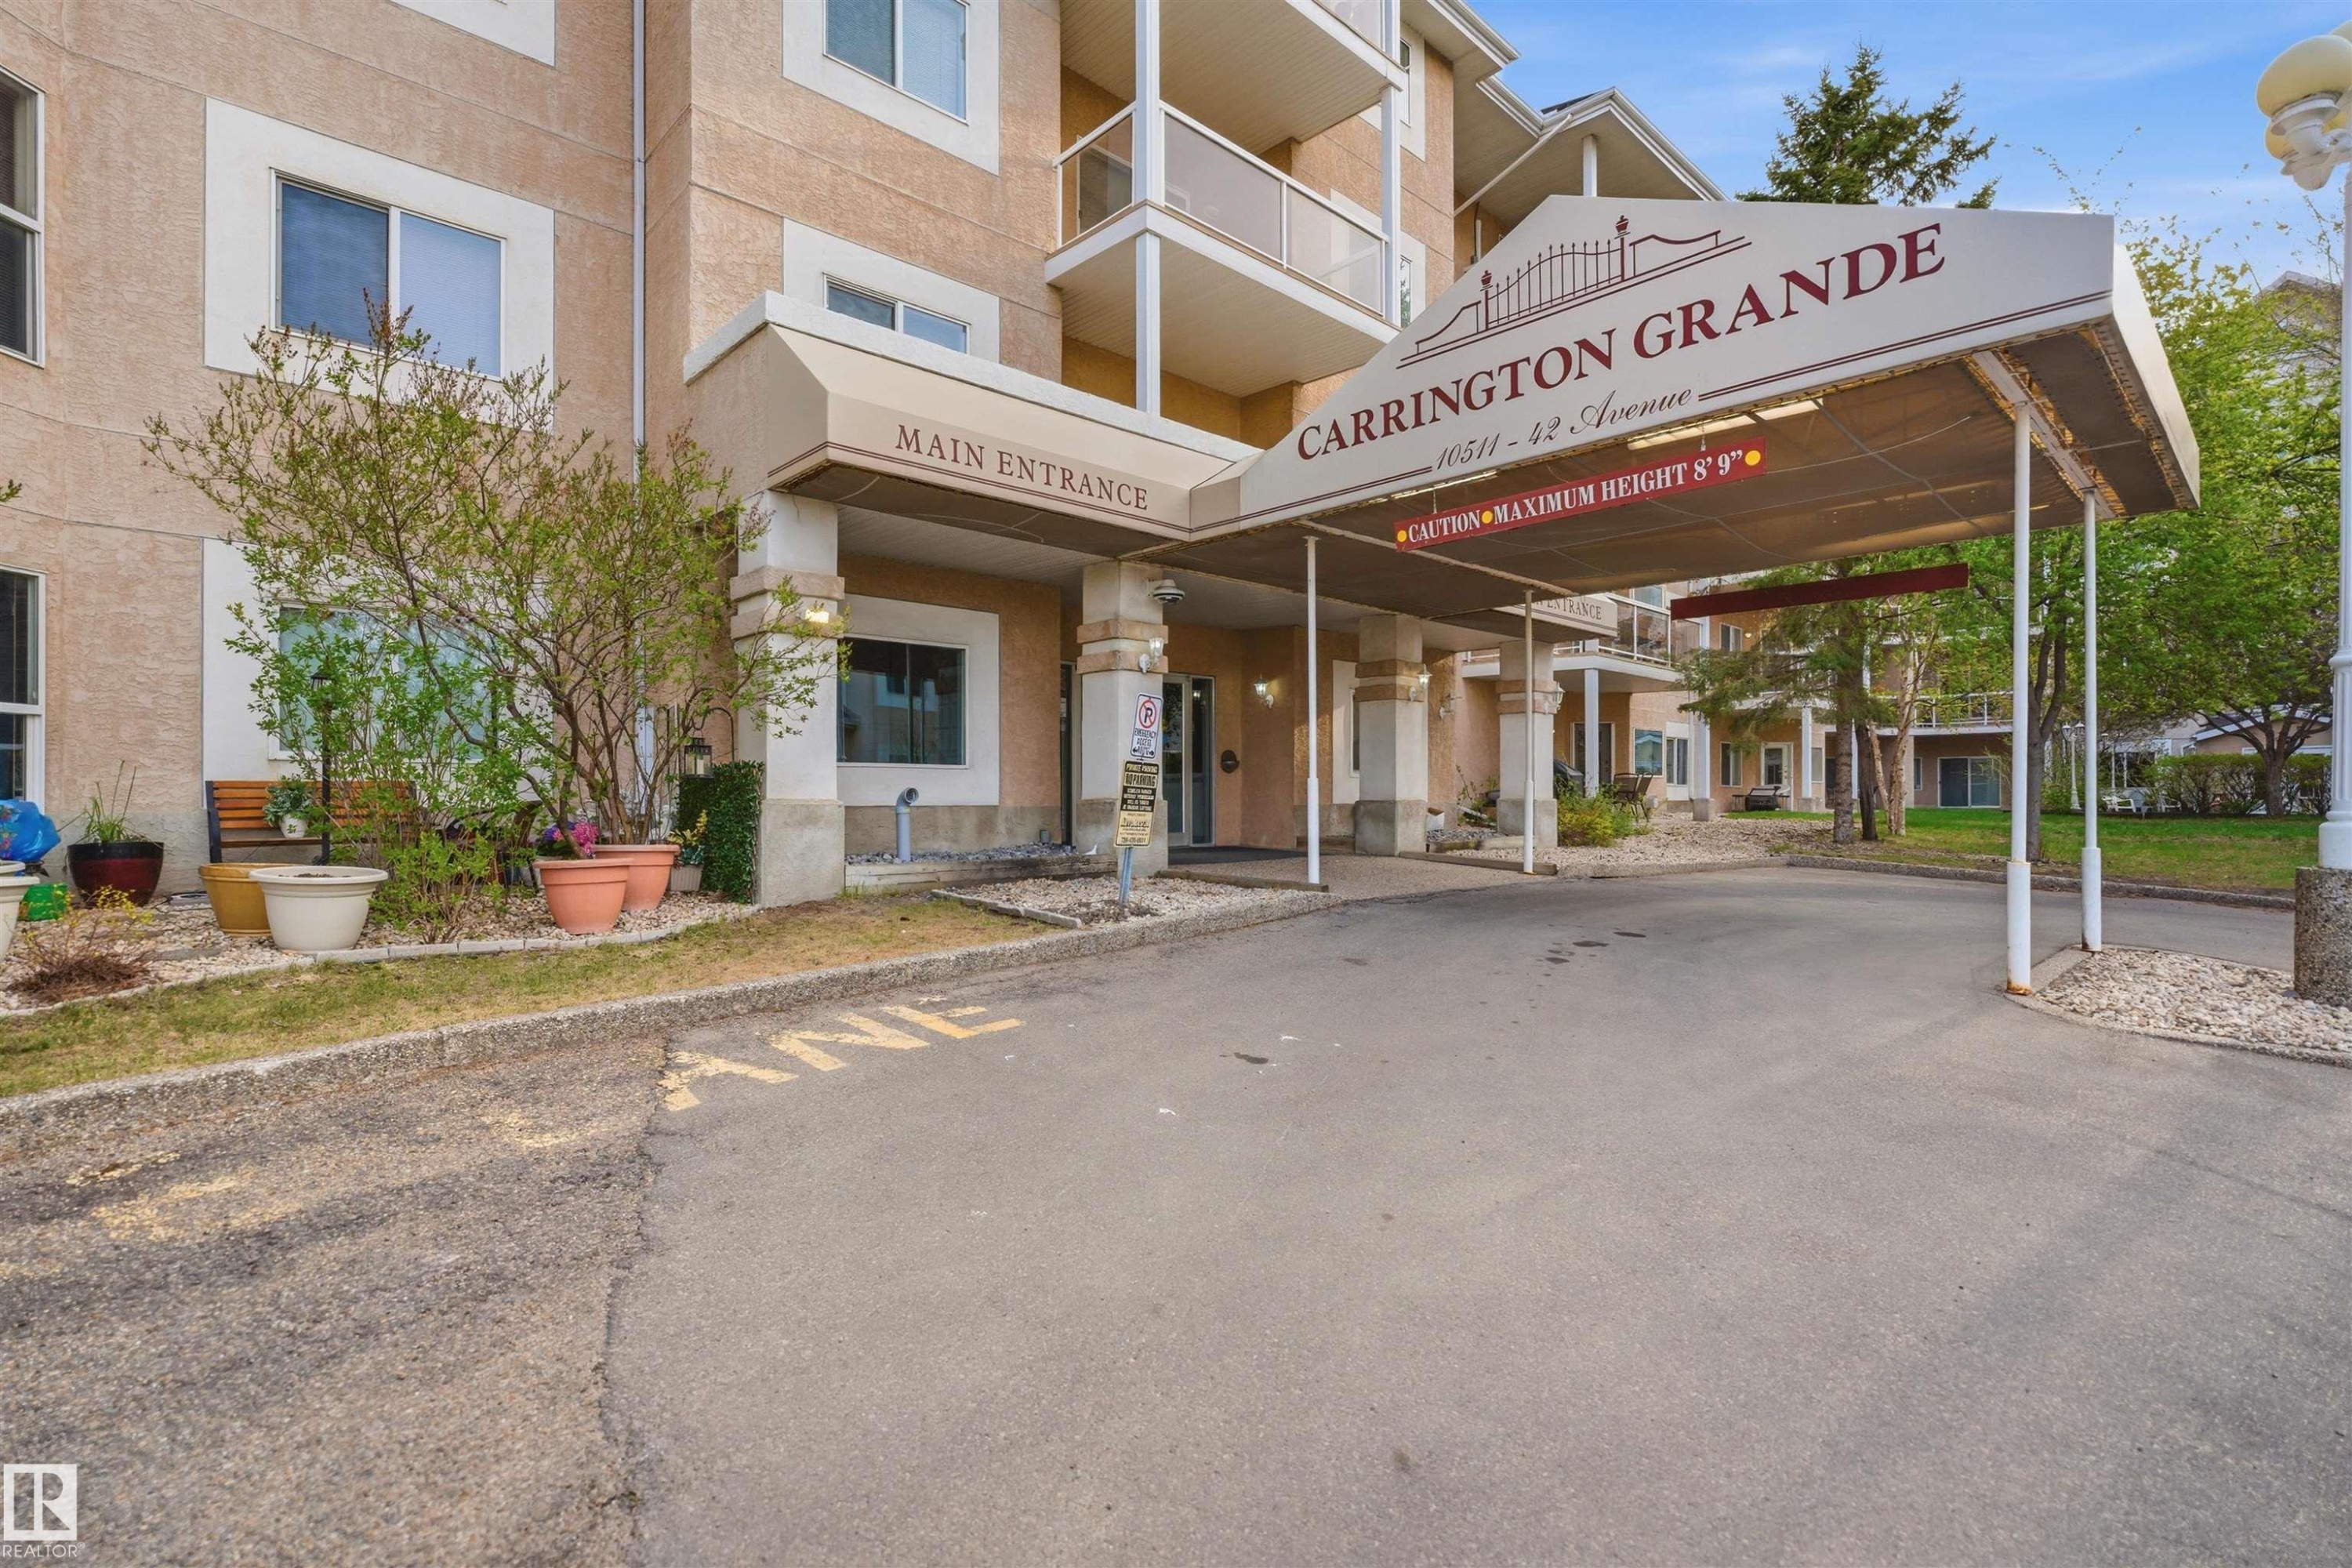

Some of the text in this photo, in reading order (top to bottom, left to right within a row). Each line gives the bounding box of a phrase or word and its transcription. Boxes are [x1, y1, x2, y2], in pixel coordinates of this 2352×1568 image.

[1298, 223, 1946, 461] CARRINGTON GRANDE
[895, 424, 1149, 510] MAIN ENTRANCE
[1436, 433, 1501, 470] 10511
[1528, 416, 1562, 445] 42
[1570, 389, 1692, 435] Avenue
[1408, 510, 1481, 543] CAUTION
[1493, 484, 1596, 525] MAXIMUM
[1600, 462, 1688, 502] HEIGHT
